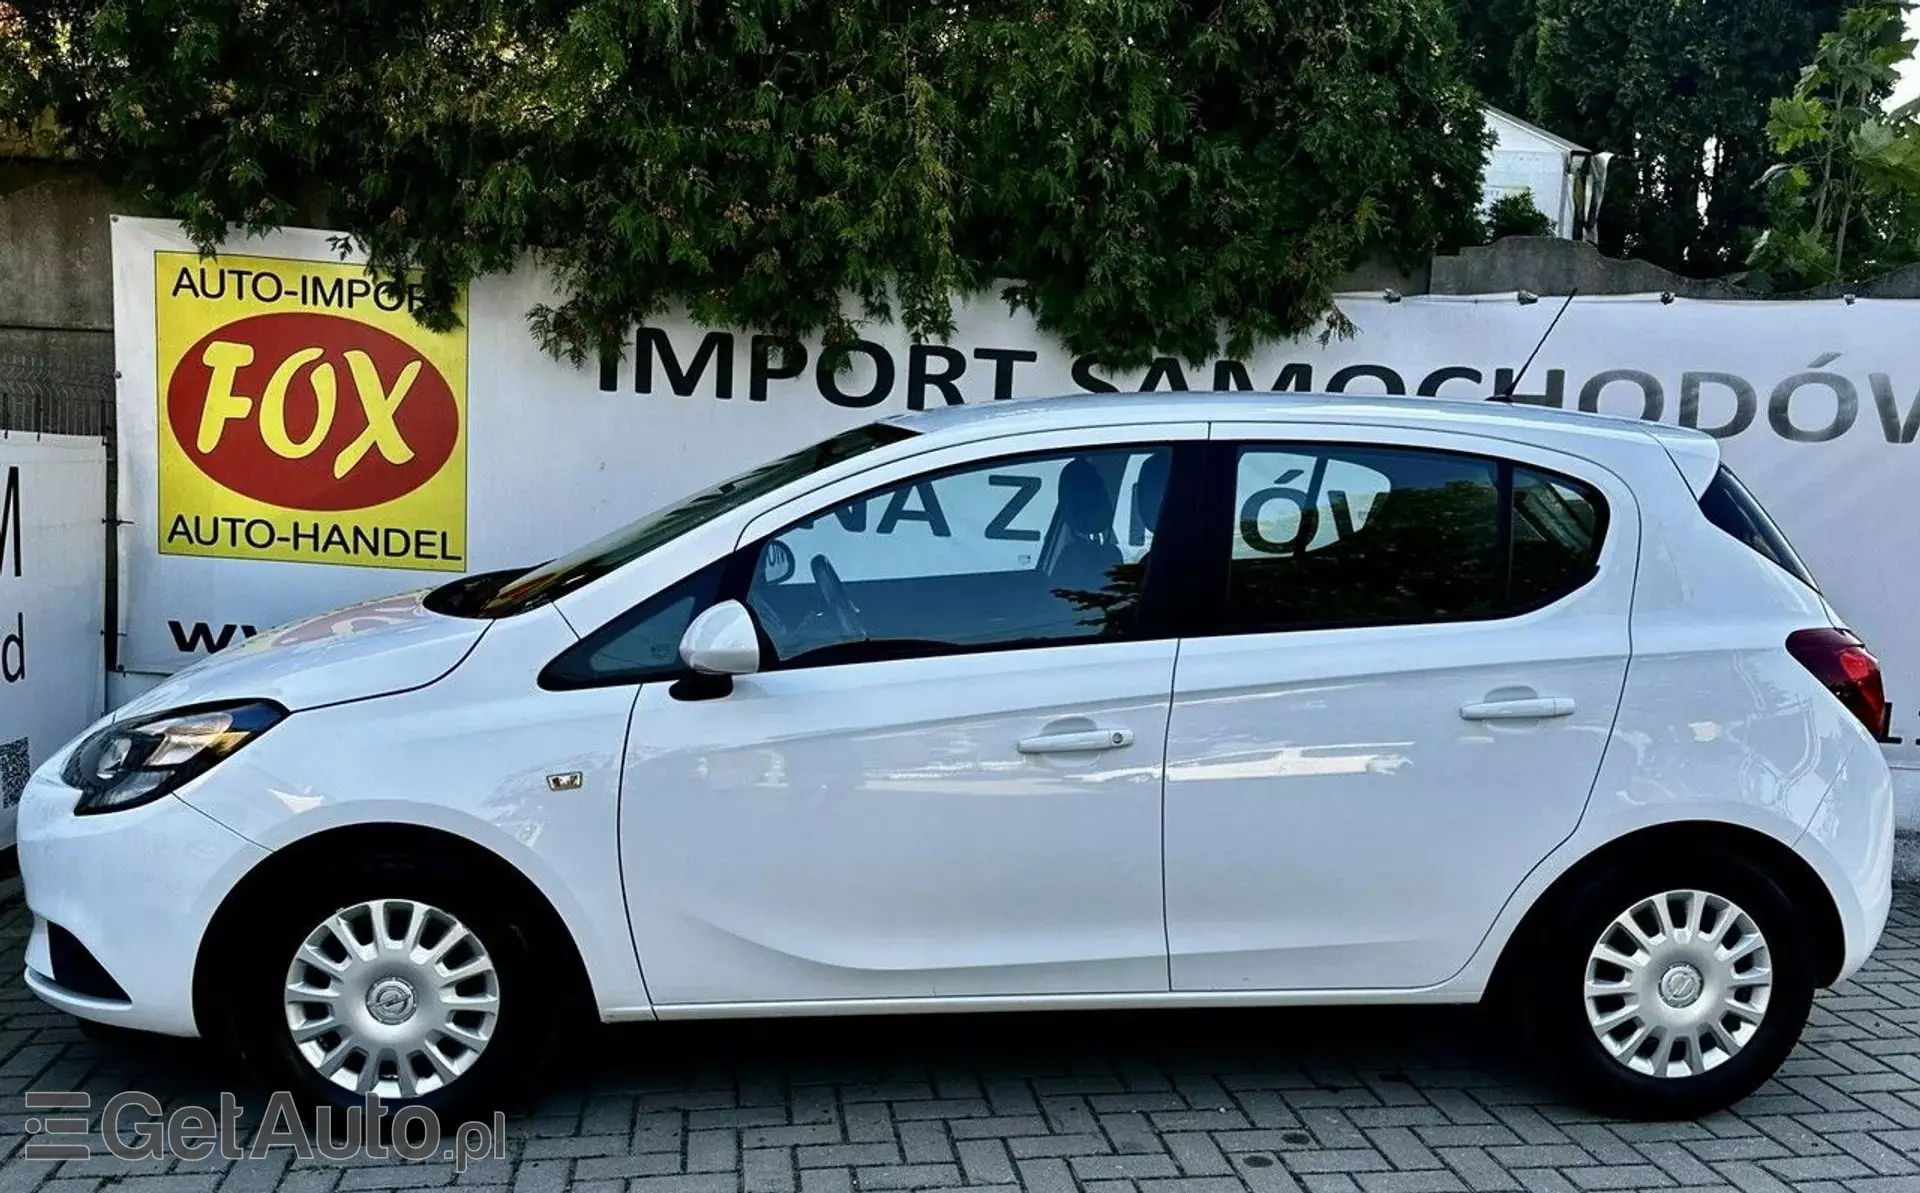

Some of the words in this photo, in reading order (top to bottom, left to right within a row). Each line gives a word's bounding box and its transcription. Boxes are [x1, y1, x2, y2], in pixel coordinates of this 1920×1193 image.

[172, 267, 428, 313] AUTO-IMPOR
[599, 327, 1037, 410] IMPORT
[196, 341, 423, 480] FOX
[167, 515, 462, 561] AUTO-HANDEL
